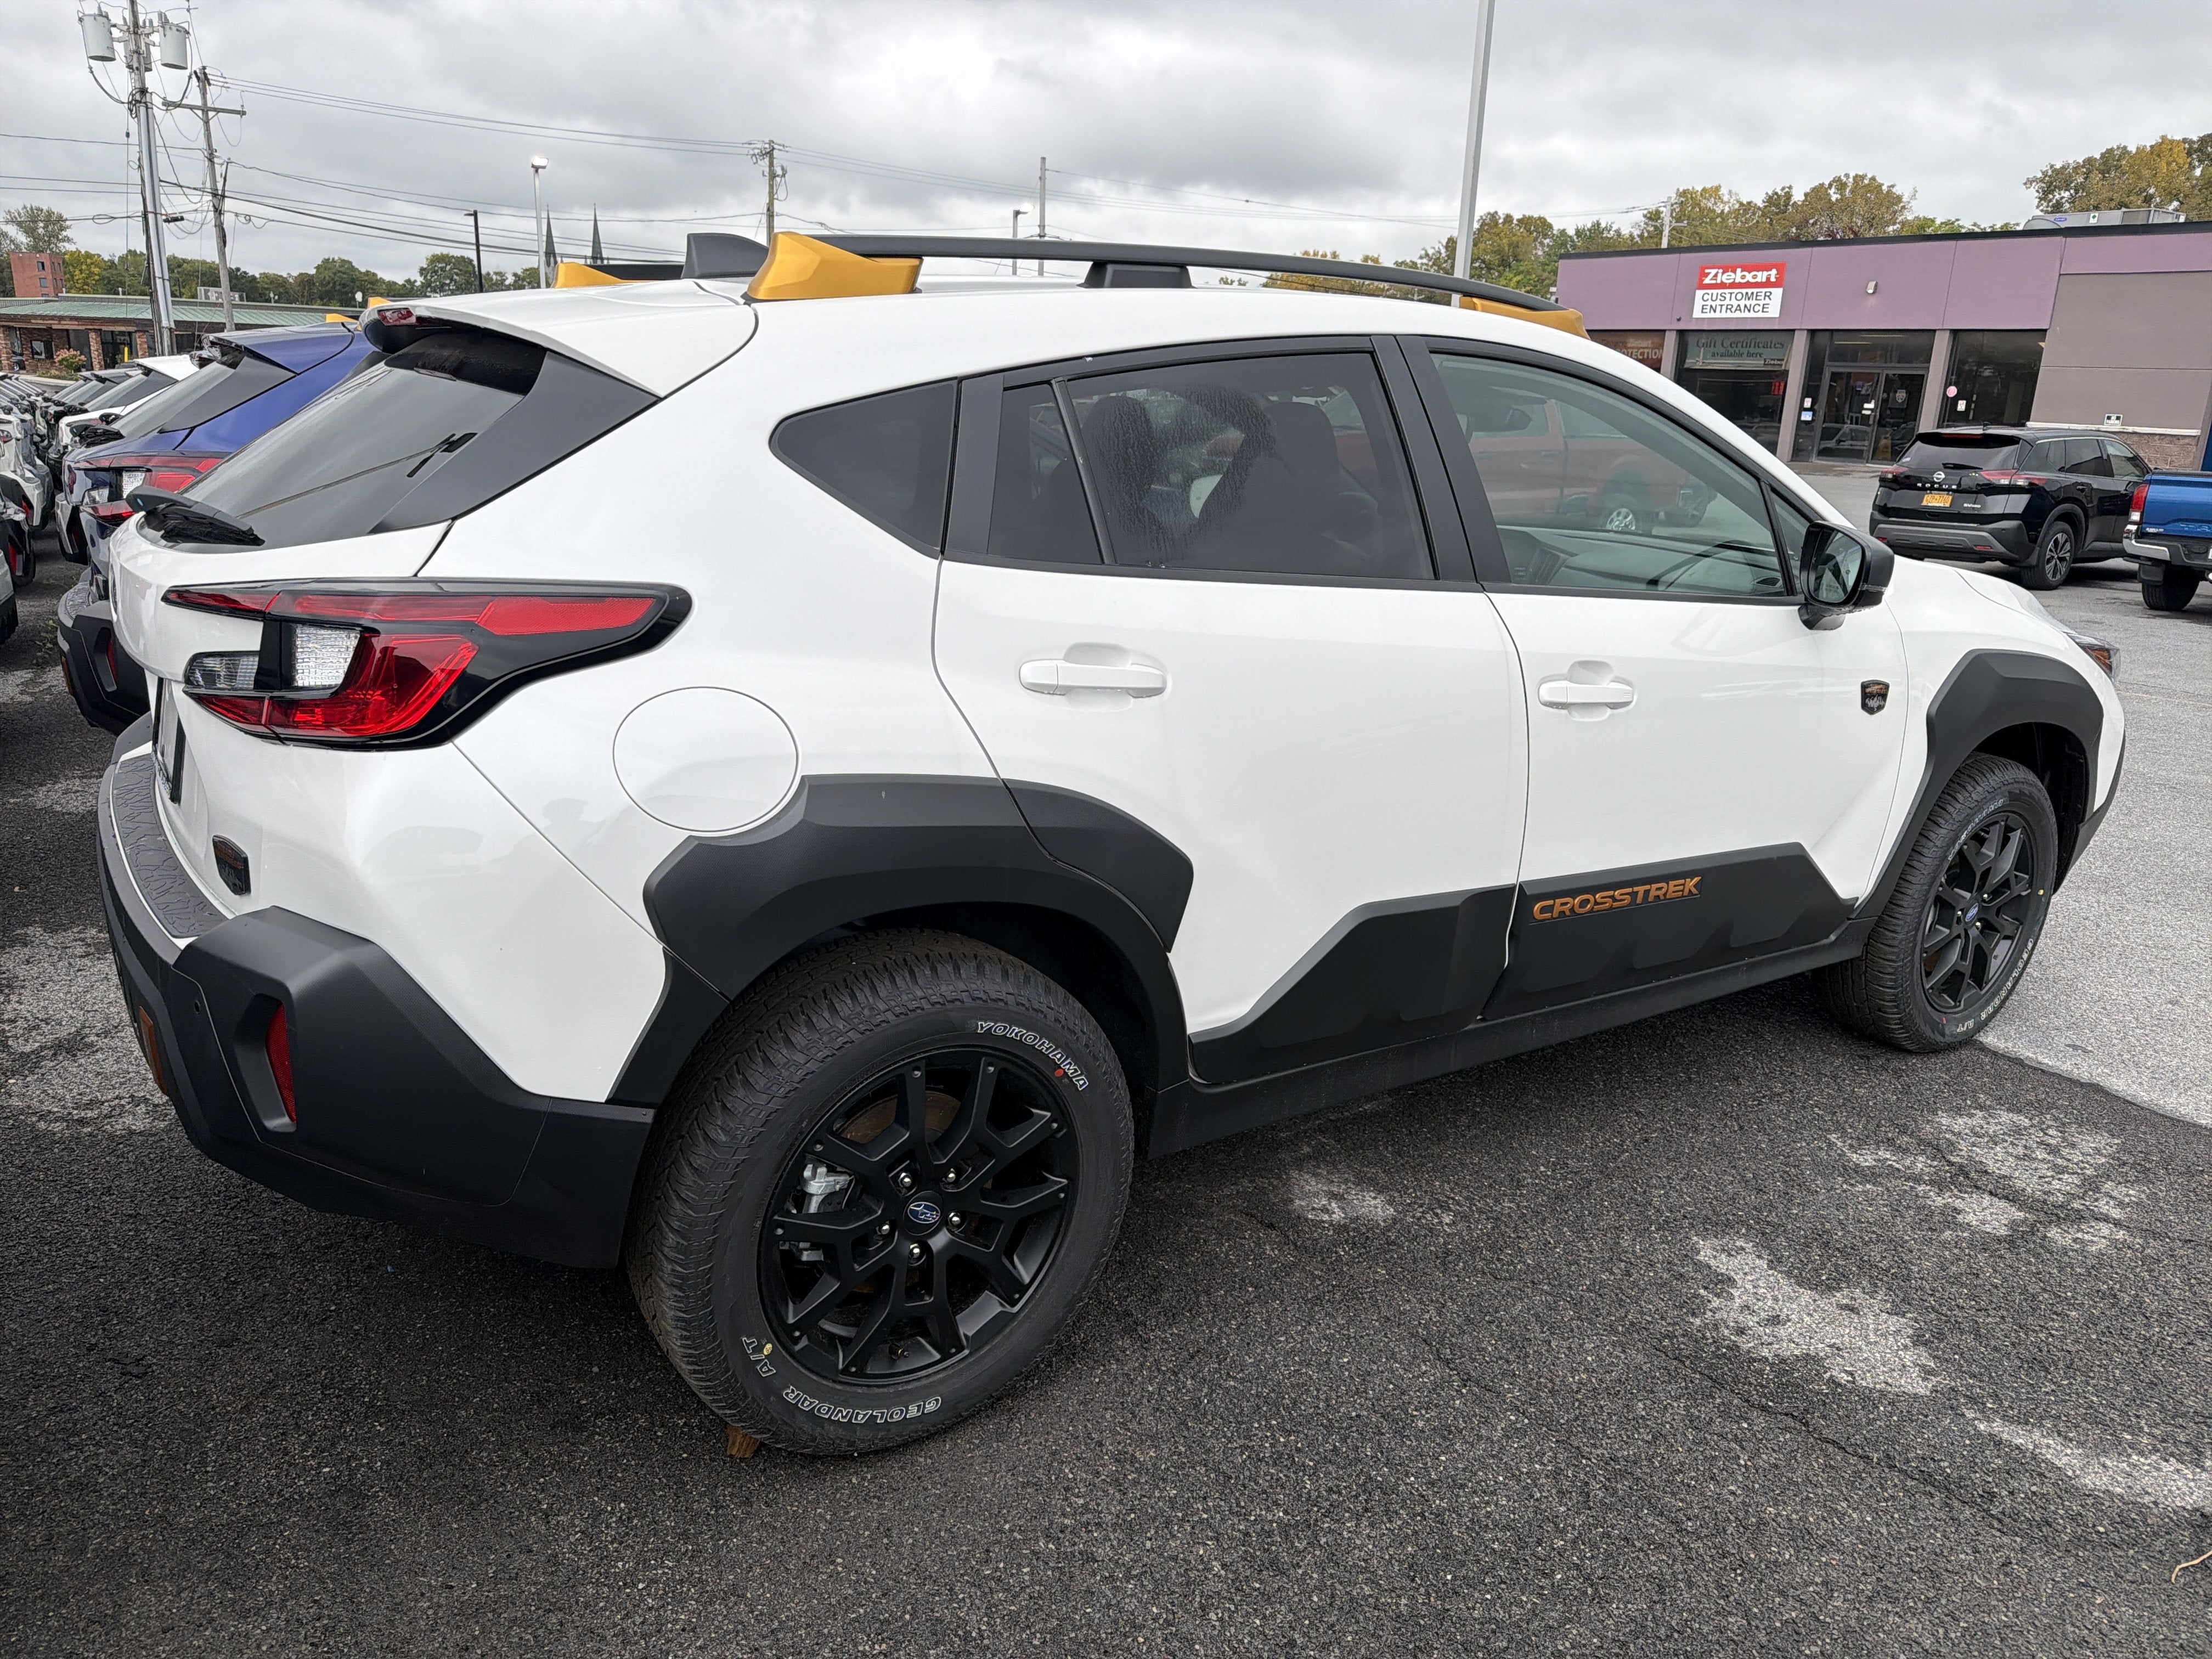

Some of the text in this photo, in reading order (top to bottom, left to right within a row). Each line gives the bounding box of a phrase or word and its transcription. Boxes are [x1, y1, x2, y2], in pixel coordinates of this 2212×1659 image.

[1702, 268, 1778, 284] Ziebart
[1701, 291, 1773, 302] CUSTOMER
[1701, 303, 1770, 314] ENTRANCE
[1696, 336, 1785, 349] Gift Certificates
[1711, 349, 1764, 358] available here
[1532, 877, 1702, 921] CROSSTREK
[1956, 938, 2034, 1032] GEOLANDAR A/T
[977, 1022, 1089, 1091] YOKOHAMA
[742, 1336, 941, 1424] GEOLANDAR A/T
